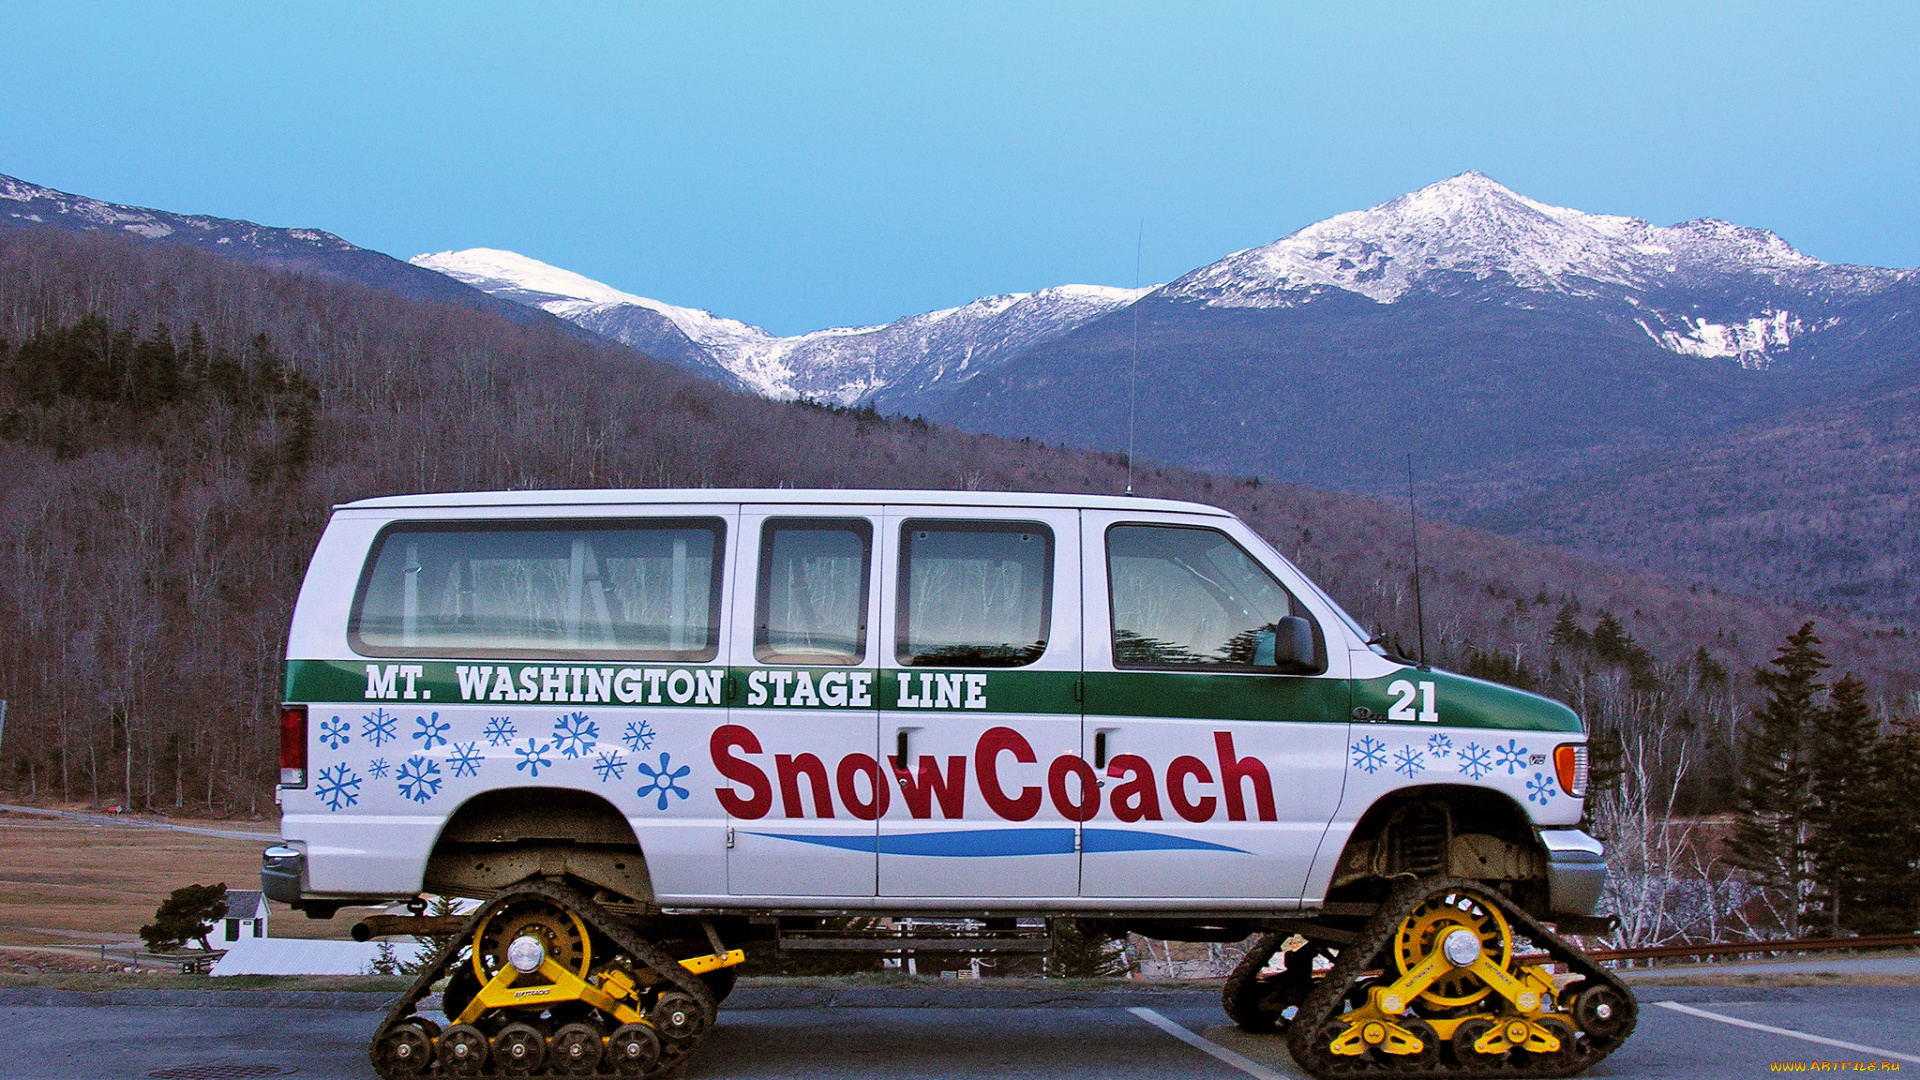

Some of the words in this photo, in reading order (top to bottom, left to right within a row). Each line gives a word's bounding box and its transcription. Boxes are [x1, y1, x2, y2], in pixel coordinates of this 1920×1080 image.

[365, 665, 430, 699] MT.
[456, 666, 725, 704] WASHINGTON
[748, 671, 872, 707] STAGE
[898, 673, 987, 708] LINE
[1388, 680, 1439, 722] 21
[711, 725, 1276, 820] SnowCoach
